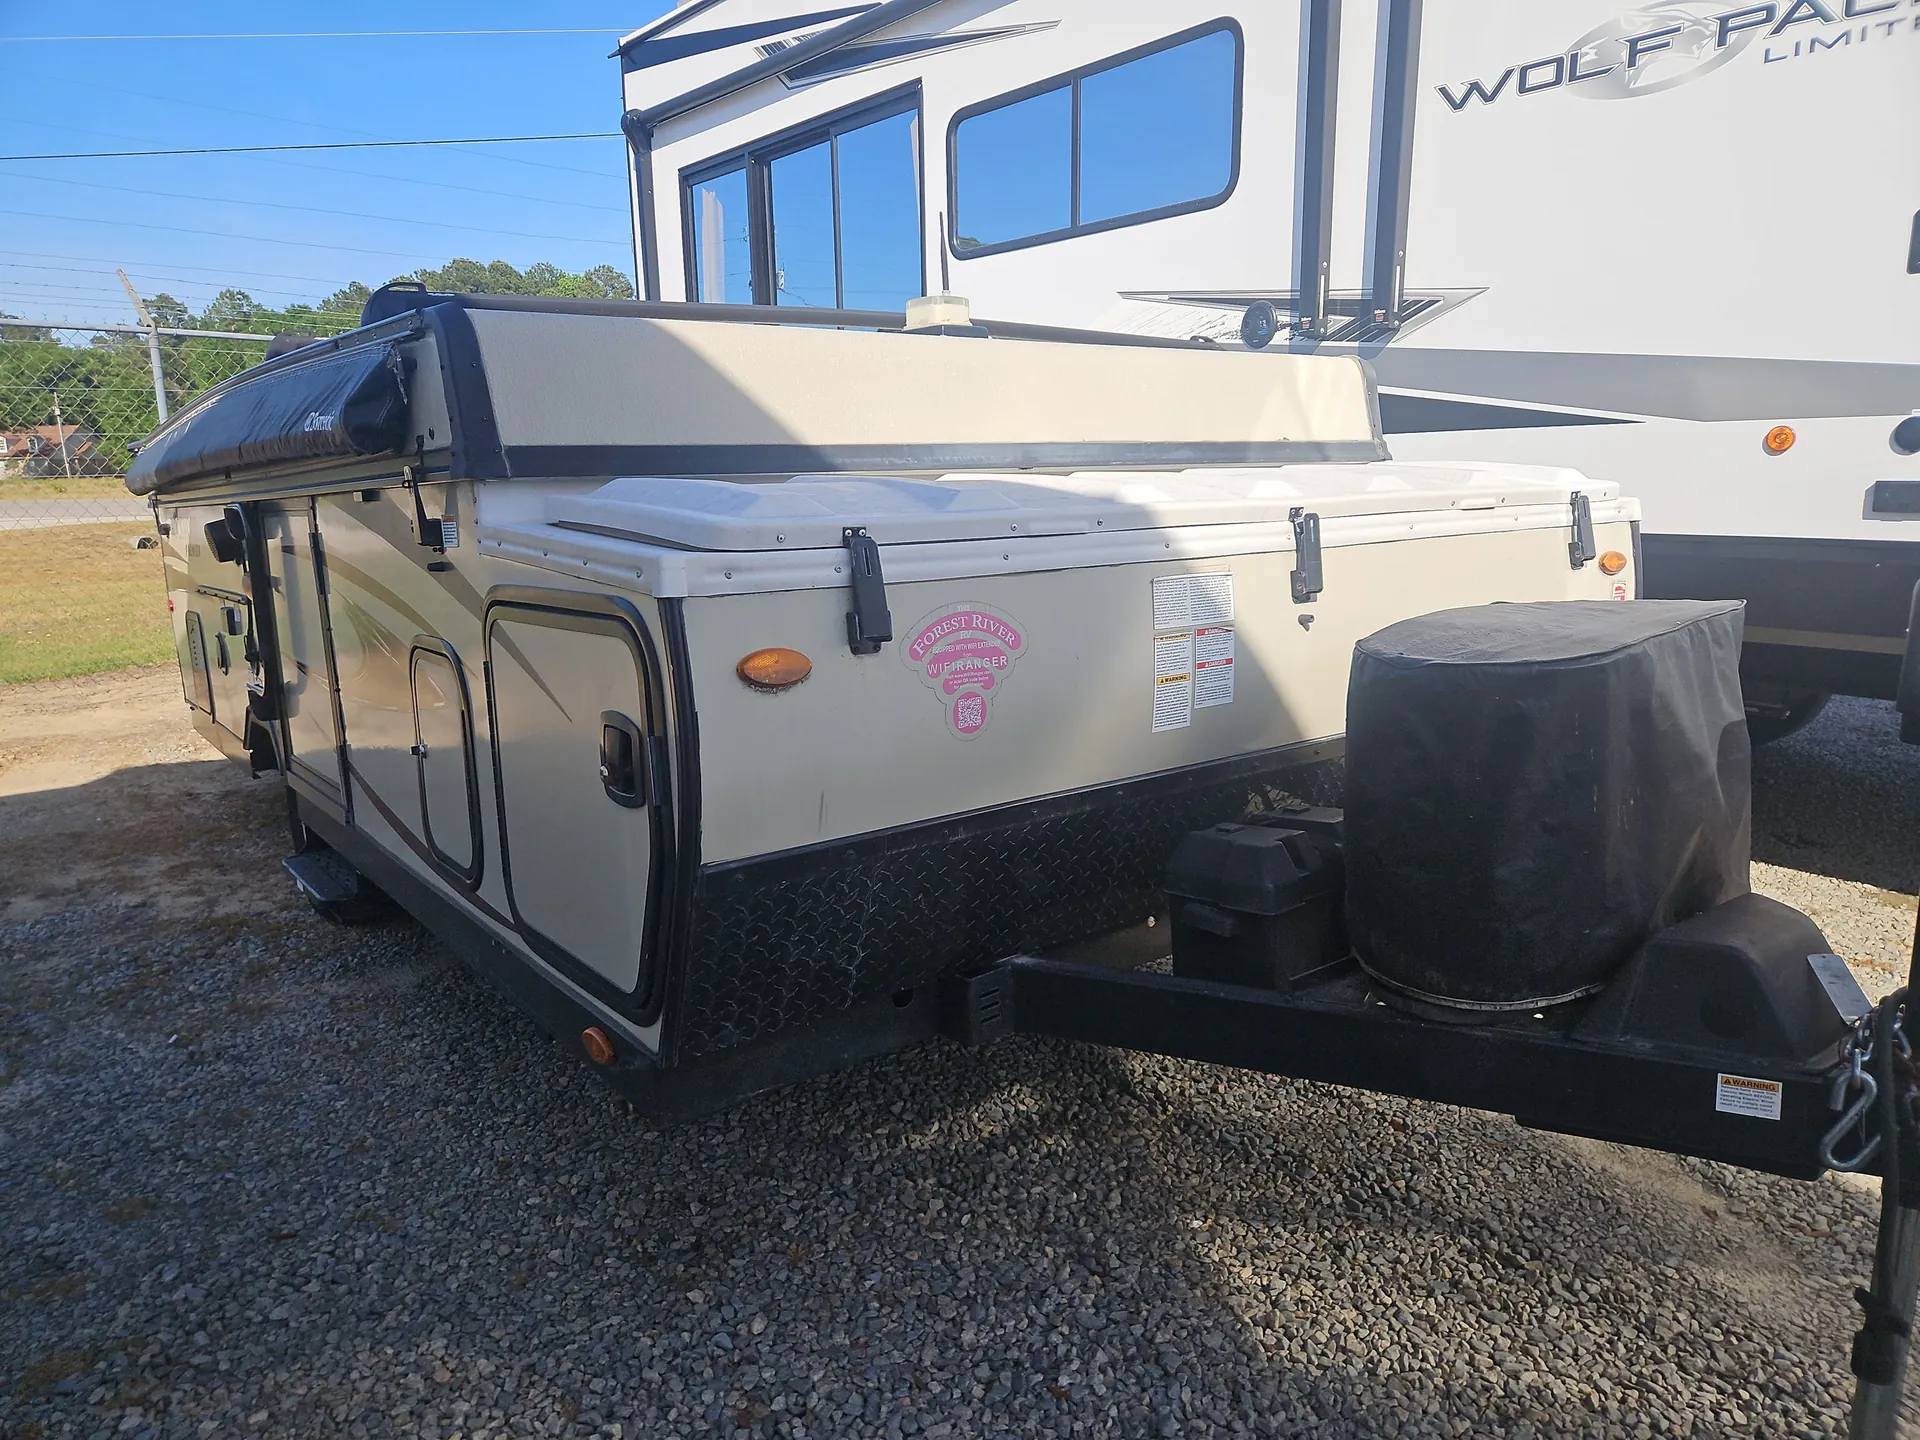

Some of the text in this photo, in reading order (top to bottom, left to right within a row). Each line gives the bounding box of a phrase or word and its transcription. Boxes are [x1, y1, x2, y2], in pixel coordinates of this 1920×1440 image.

[1434, 24, 1684, 113] WOLF
[912, 614, 1016, 656] FOREST RIVER
[960, 630, 972, 639] RV
[927, 656, 1008, 675] WIFIRANGER
[1165, 674, 1187, 682] WARNING
[1732, 1078, 1776, 1091] WARNING
